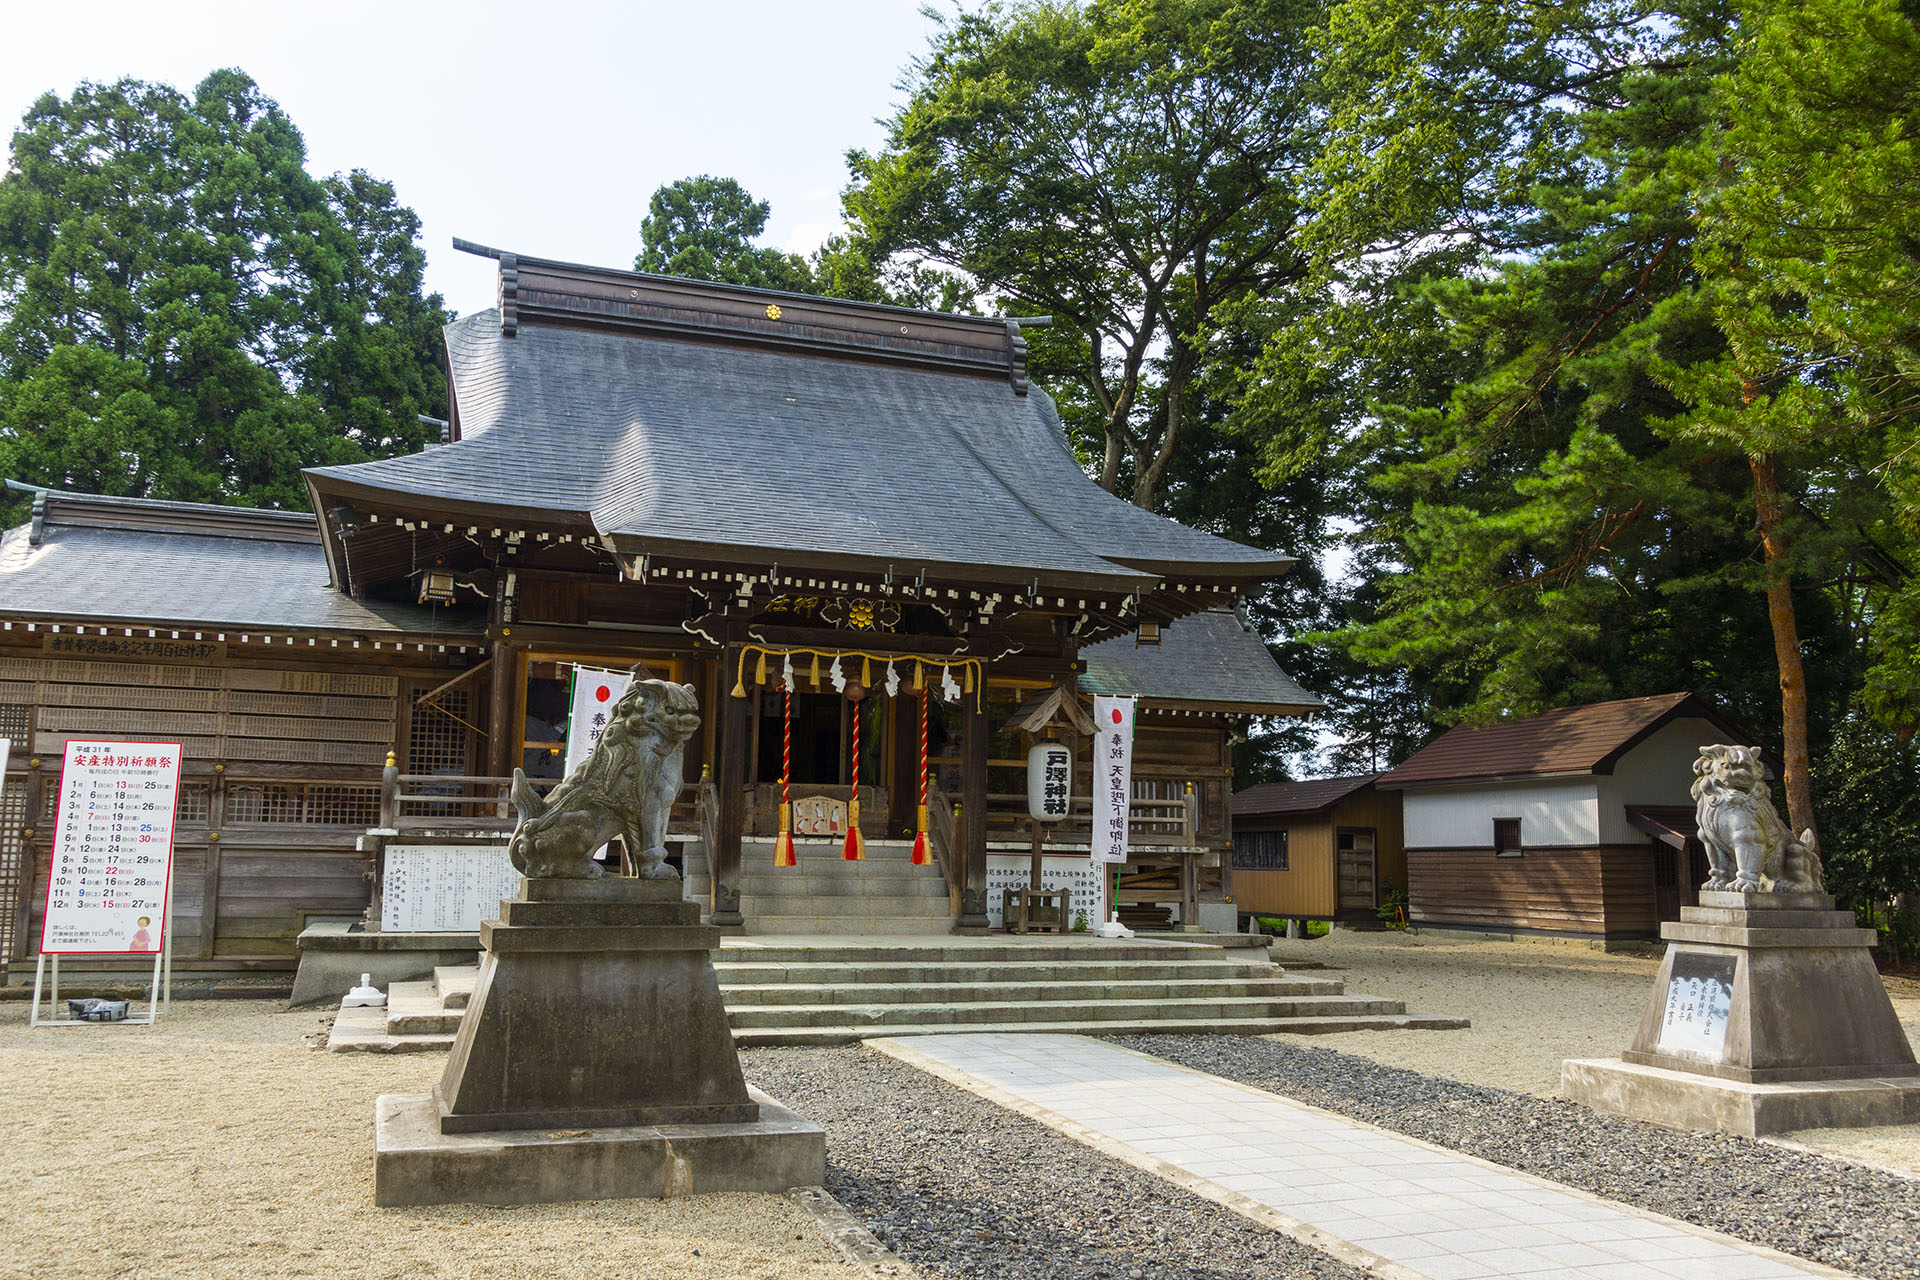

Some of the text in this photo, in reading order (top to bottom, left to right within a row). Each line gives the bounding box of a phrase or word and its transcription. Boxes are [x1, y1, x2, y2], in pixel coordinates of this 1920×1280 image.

[73, 754, 172, 768] 安産特別祈願祭
[1044, 751, 1068, 814] 戸澤神社
